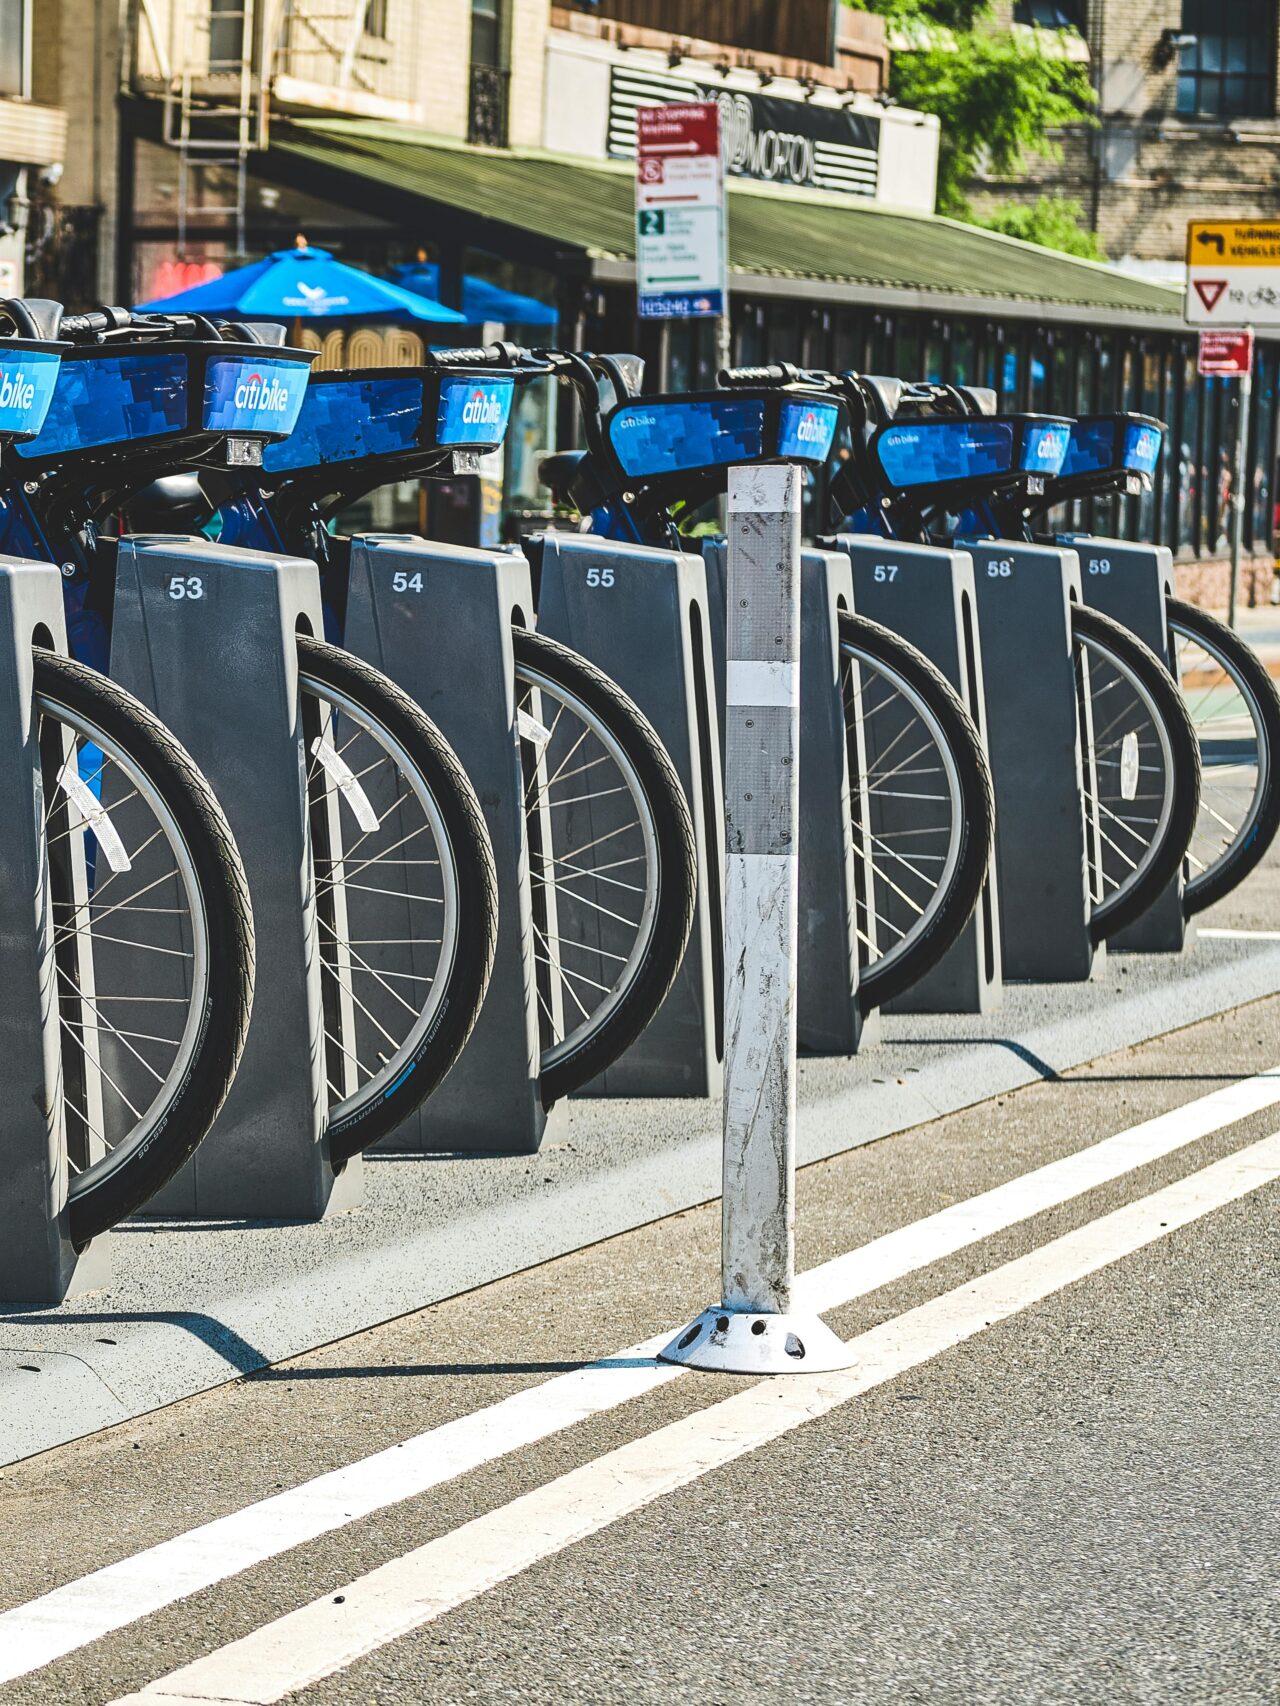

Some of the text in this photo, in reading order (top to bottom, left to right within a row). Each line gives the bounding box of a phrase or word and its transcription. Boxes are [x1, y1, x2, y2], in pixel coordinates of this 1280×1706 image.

[874, 565, 898, 583] 57
[986, 560, 1012, 577] 58
[1089, 559, 1111, 574] 59
[392, 571, 424, 593] 54
[586, 568, 615, 588] 55
[169, 576, 204, 601] 53
